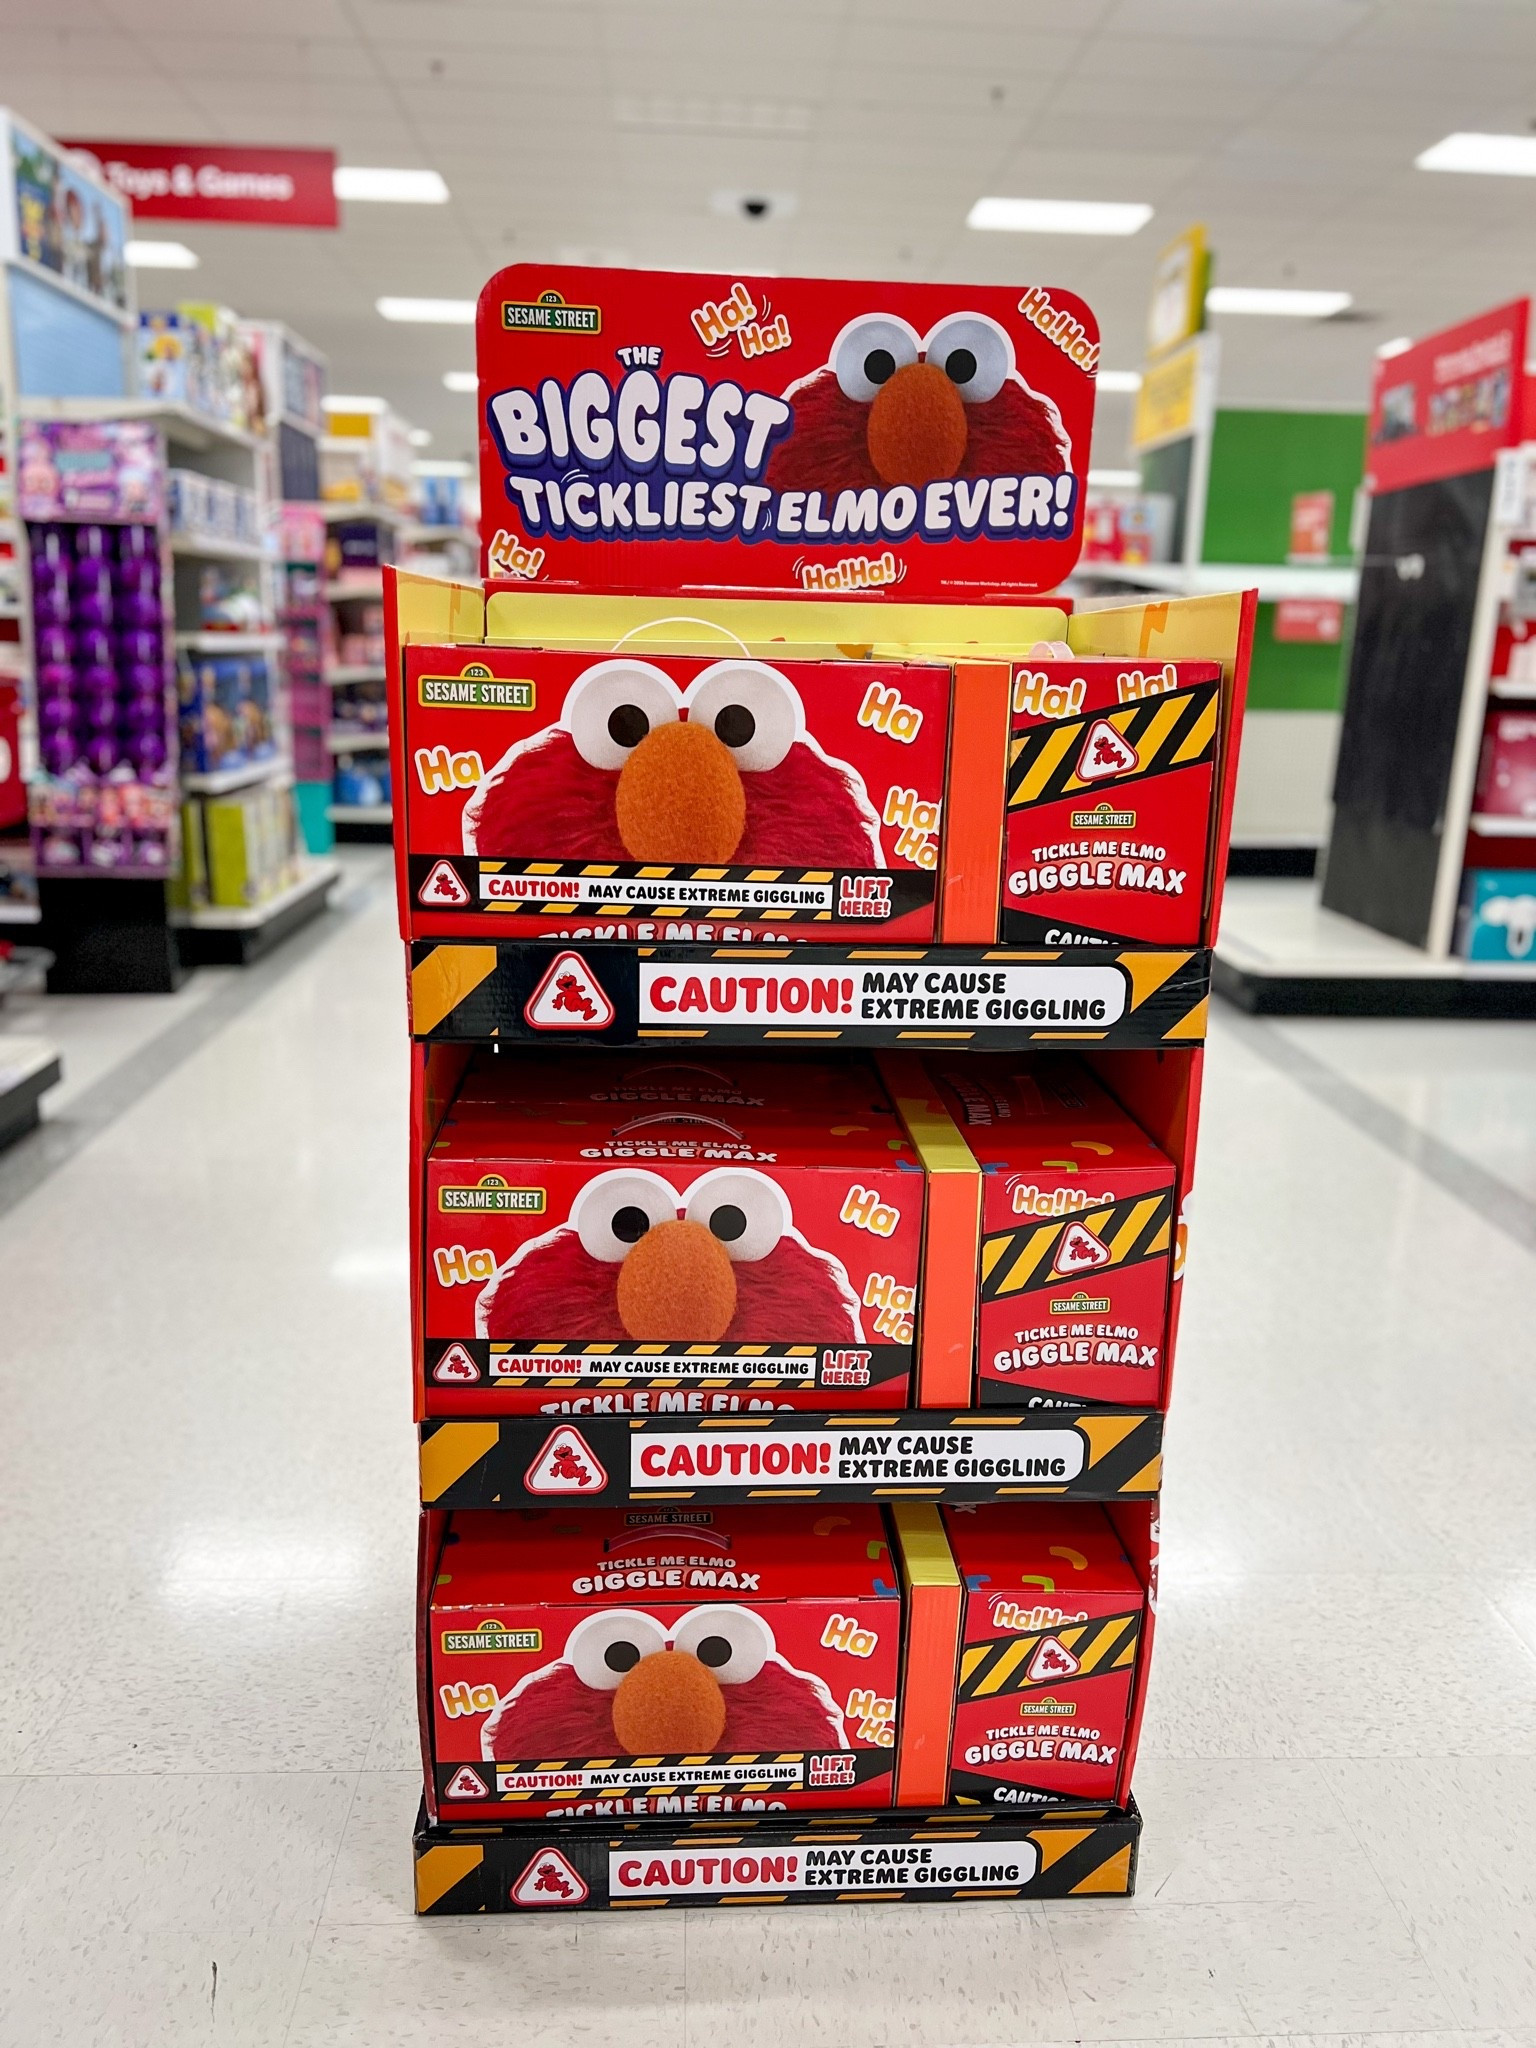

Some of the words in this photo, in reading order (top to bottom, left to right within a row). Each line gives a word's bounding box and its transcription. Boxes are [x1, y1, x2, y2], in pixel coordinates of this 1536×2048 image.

[196, 165, 294, 200] Games
[507, 307, 552, 326] SESAME
[554, 310, 596, 328] STREET
[692, 284, 756, 345] Ha!
[738, 315, 791, 357] Ha!
[618, 346, 661, 366] THE
[491, 369, 790, 470] BIGGEST
[509, 476, 772, 530] TICKLIEST
[776, 486, 918, 533] ELMO
[924, 474, 1073, 530] EVER!
[490, 530, 544, 578] Ha!
[470, 668, 484, 677] 123
[425, 682, 478, 702] SESAME
[480, 684, 530, 705] STREET
[1014, 672, 1085, 717] Ha!
[859, 683, 921, 741] Ha
[417, 748, 482, 792] Ha
[1074, 814, 1104, 825] SESAME
[1105, 814, 1132, 825] STREET
[1032, 841, 1089, 862] TICKLE
[1093, 841, 1117, 856] ME
[1121, 842, 1166, 862] ELMO
[841, 878, 892, 900] LIFT
[1008, 862, 1113, 896] GIGGLE
[1119, 863, 1187, 894] MAX
[488, 879, 580, 898] CAUTION!
[588, 884, 622, 898] MAY
[626, 885, 675, 900] CAUSE
[679, 887, 750, 902] EXTREME
[754, 889, 825, 905] GIGGLING
[839, 900, 890, 916] HERE!
[861, 972, 919, 994] MAY
[924, 972, 1007, 994] CAUSE
[649, 976, 854, 1014] CAUTION!
[861, 998, 978, 1020] EXTREME
[985, 998, 1106, 1021] GIGGLING
[589, 1092, 692, 1102] GIGGLE
[700, 1094, 765, 1106] MAX
[580, 1148, 696, 1158] GIGGLE
[704, 1149, 778, 1163] MAX
[605, 1140, 667, 1148] TICKLE
[671, 1140, 698, 1148] ME
[702, 1142, 752, 1150] ELMO
[445, 1191, 492, 1208] SESAME
[496, 1192, 541, 1209] STREET
[841, 1186, 899, 1235] Ha
[435, 1247, 495, 1285] Ha
[1053, 1302, 1080, 1312] SESAME
[1082, 1300, 1107, 1310] STREET
[1014, 1325, 1068, 1343] TICKLE
[1070, 1324, 1094, 1336] ME
[1096, 1324, 1138, 1340] ELMO
[497, 1358, 582, 1374] CAUTION!
[590, 1361, 622, 1373] MAY
[624, 1361, 670, 1374] CAUSE
[674, 1362, 739, 1374] EXTREME
[742, 1362, 809, 1375] GIGGLING
[824, 1351, 870, 1370] LIFT
[994, 1342, 1090, 1372] GIGGLE
[1096, 1343, 1159, 1367] MAX
[822, 1371, 869, 1384] HERE!
[658, 1391, 704, 1412] ME
[838, 1436, 892, 1456] MAY
[896, 1436, 974, 1455] CAUSE
[640, 1442, 832, 1477] CAUTION!
[838, 1458, 949, 1479] EXTREME
[954, 1458, 1066, 1478] GIGGLING
[629, 1514, 668, 1524] SESAME
[672, 1514, 709, 1523] STREET
[597, 1556, 656, 1571] TICKLE
[659, 1556, 686, 1566] ME
[688, 1556, 736, 1568] ELMO
[572, 1570, 682, 1595] GIGGLE
[690, 1571, 761, 1591] MAX
[447, 1634, 492, 1651] SESAME
[495, 1632, 536, 1650] STREET
[822, 1614, 877, 1656] Ha
[441, 1683, 498, 1717] Ha
[1024, 1705, 1048, 1714] SESAME
[1050, 1705, 1073, 1714] STREET
[986, 1726, 1035, 1740] TICKLE
[1038, 1725, 1059, 1736] ME
[1062, 1726, 1100, 1740] ELMO
[964, 1740, 1053, 1765] GIGGLE
[1058, 1742, 1117, 1764] MAX
[811, 1756, 854, 1772] LIFT
[504, 1774, 583, 1789] CAUTION!
[590, 1773, 620, 1785] MAY
[622, 1772, 666, 1783] CAUSE
[669, 1770, 732, 1782] EXTREME
[734, 1768, 797, 1780] GIGGLING
[810, 1772, 854, 1786] HERE!
[656, 1796, 700, 1814] ME
[806, 1849, 856, 1866] MAY
[860, 1848, 932, 1865] CAUSE
[618, 1856, 798, 1888] CAUTION!
[804, 1867, 909, 1886] EXTREME
[914, 1864, 1020, 1883] GIGGLING
